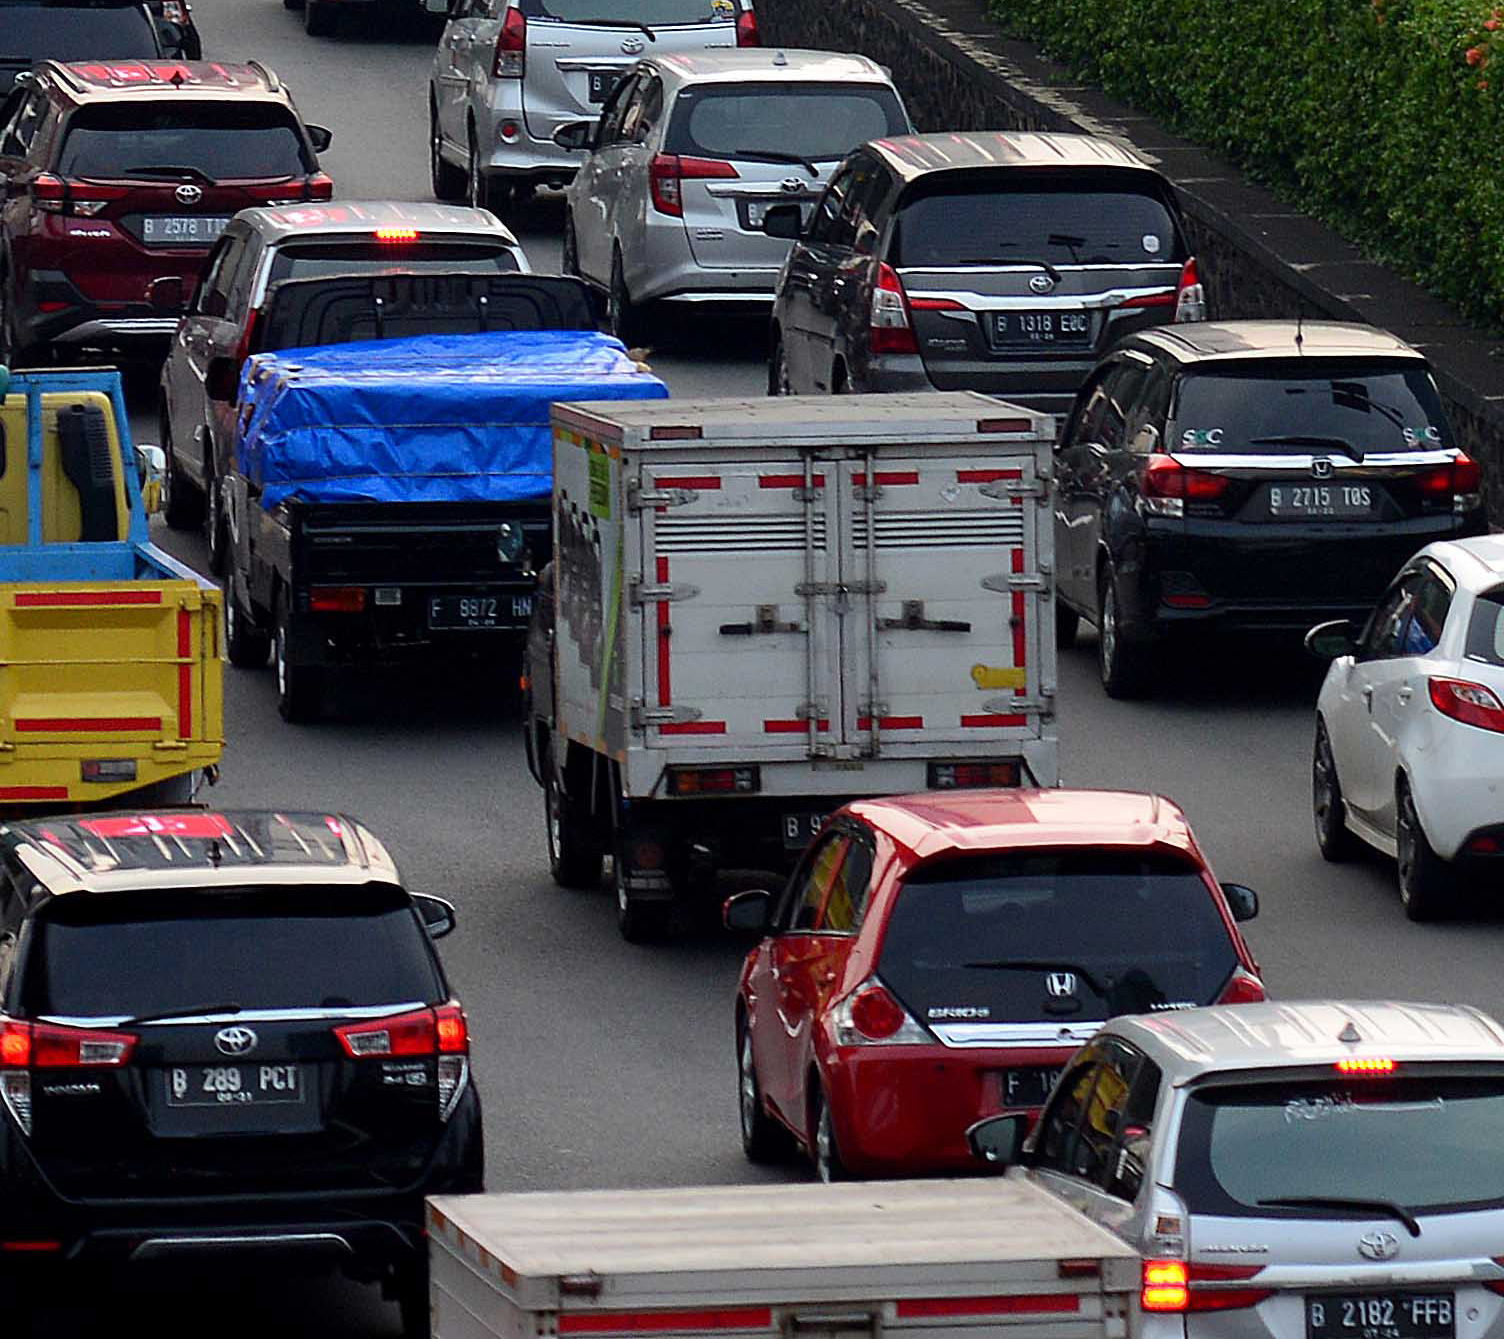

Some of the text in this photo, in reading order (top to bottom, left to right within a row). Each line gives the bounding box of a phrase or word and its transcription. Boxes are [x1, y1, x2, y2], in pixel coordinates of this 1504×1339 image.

[143, 218, 153, 234] B
[997, 315, 1008, 331] B
[1019, 315, 1052, 332] 1318
[1271, 487, 1282, 507] B
[1293, 487, 1330, 507] 2715
[431, 599, 441, 617] F
[787, 816, 800, 838] B
[172, 1066, 297, 1093] B 289 PCT
[1007, 1072, 1019, 1094] F
[1311, 1299, 1454, 1328] B 2182 FFB
